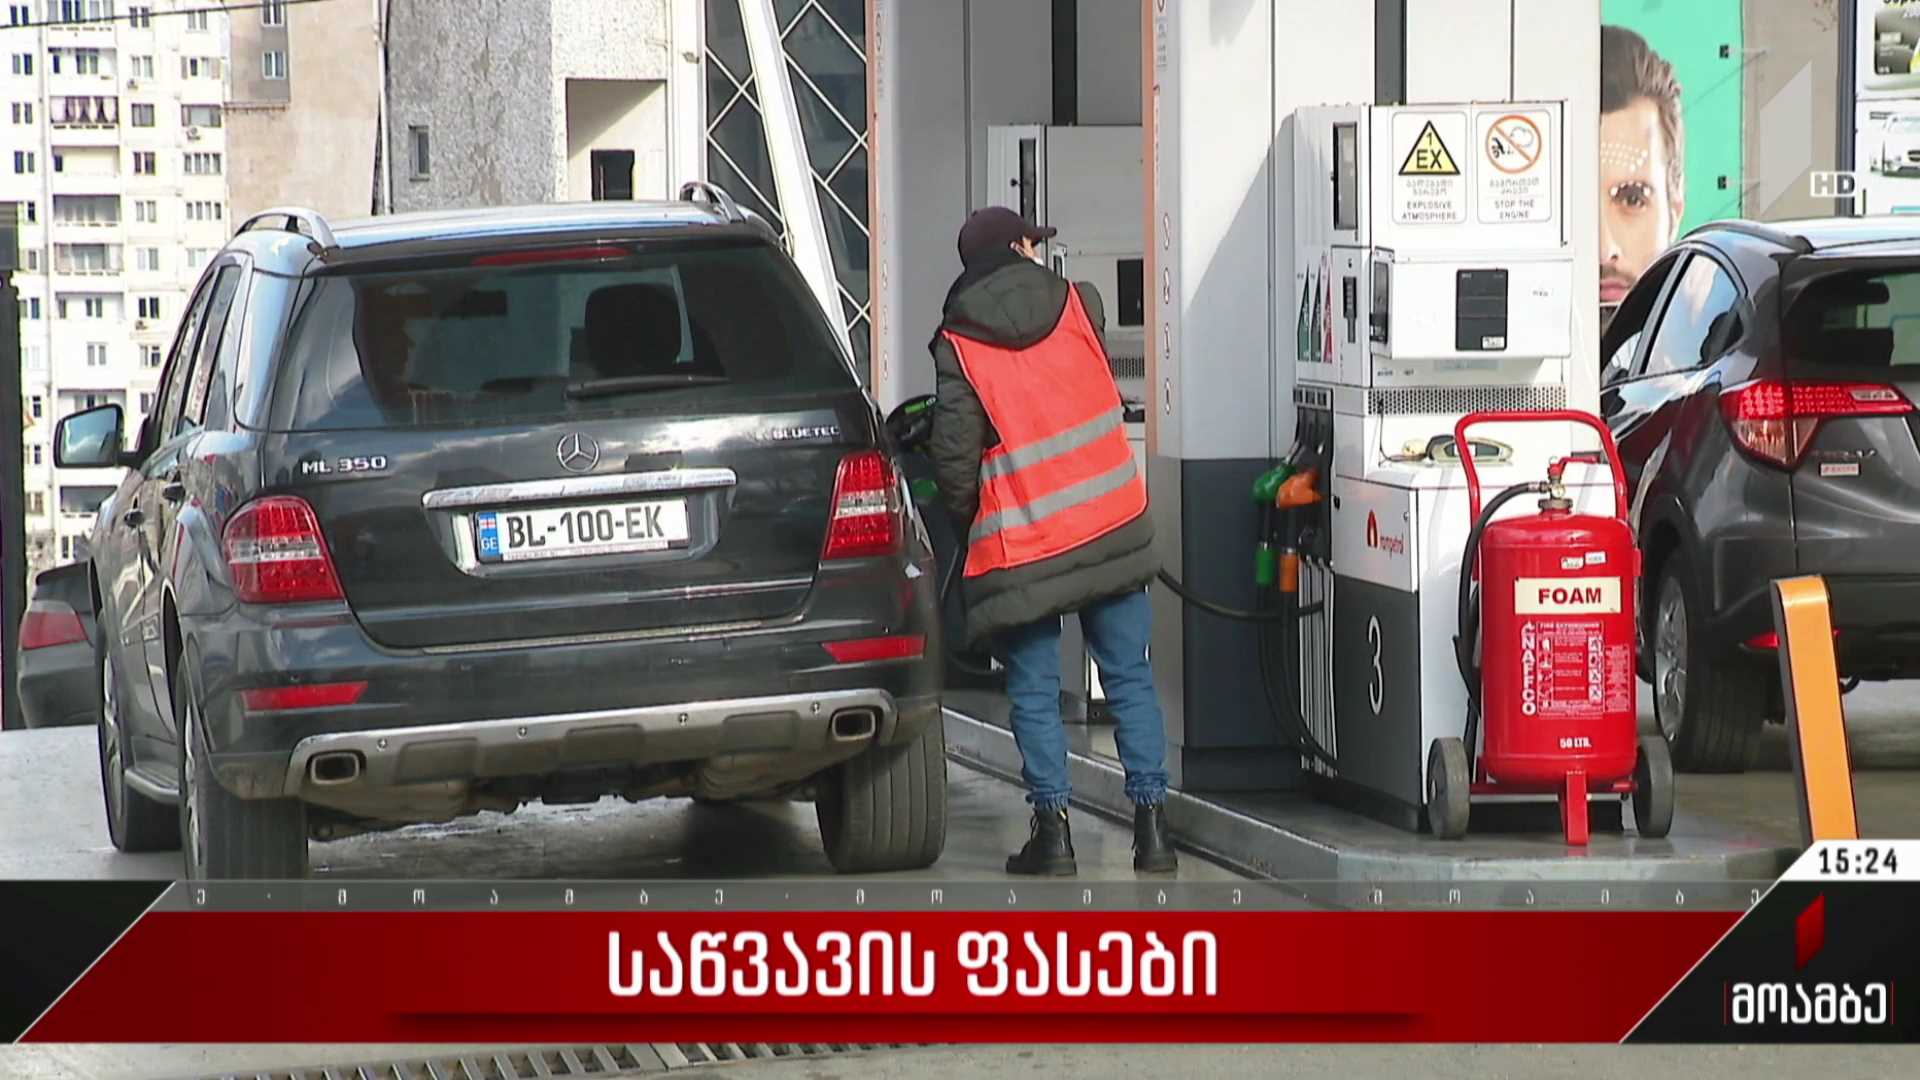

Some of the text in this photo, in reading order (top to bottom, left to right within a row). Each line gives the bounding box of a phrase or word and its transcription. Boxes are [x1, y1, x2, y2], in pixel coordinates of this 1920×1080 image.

[1427, 132, 1433, 146] 1
[1416, 149, 1442, 169] EX
[1519, 200, 1534, 208] THE
[1402, 211, 1456, 220] ATMOSPHERE
[1500, 211, 1529, 219] ENGINE
[772, 426, 840, 440] BLUETEC
[302, 456, 387, 474] ML 350
[506, 505, 665, 548] BL-100-EK
[481, 536, 498, 550] GE
[1538, 587, 1602, 604] FOAM
[1368, 614, 1384, 716] 3
[1560, 737, 1573, 748] 50
